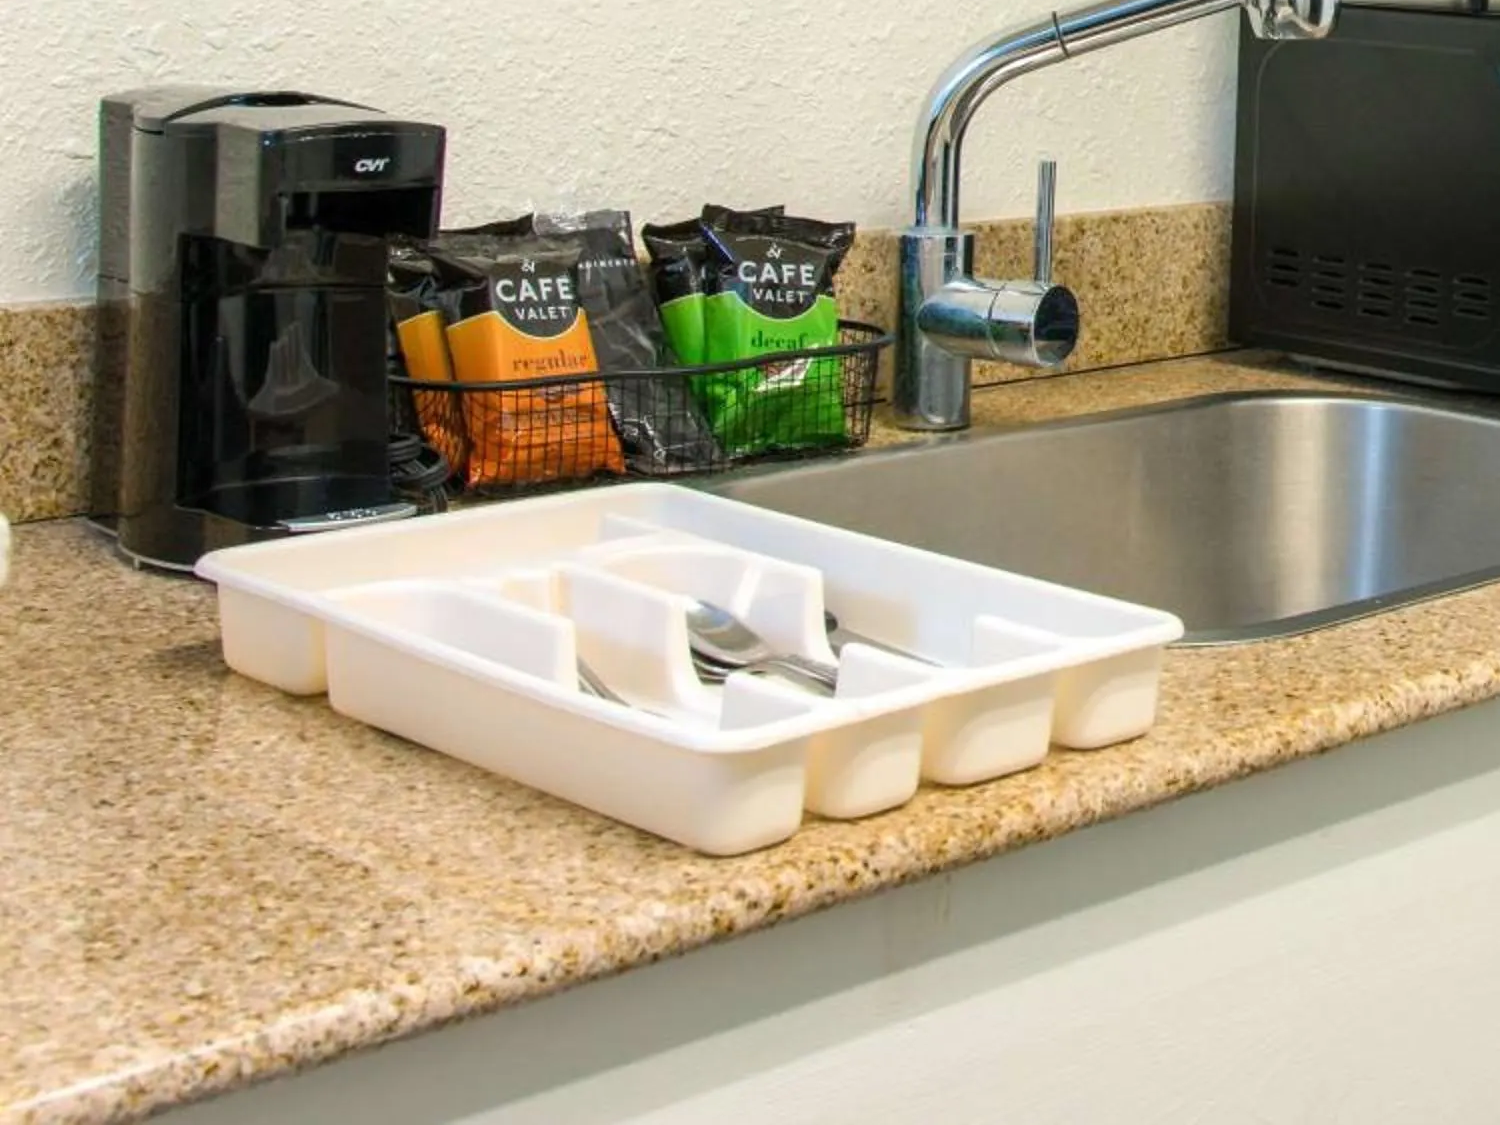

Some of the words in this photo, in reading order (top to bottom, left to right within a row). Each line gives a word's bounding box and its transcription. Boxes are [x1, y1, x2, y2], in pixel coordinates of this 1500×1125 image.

[738, 260, 816, 286] CAFE
[495, 277, 574, 302] CAFE
[753, 287, 804, 304] VALET
[515, 306, 571, 319] VALET
[751, 330, 809, 350] decaf
[513, 348, 588, 373] regular
